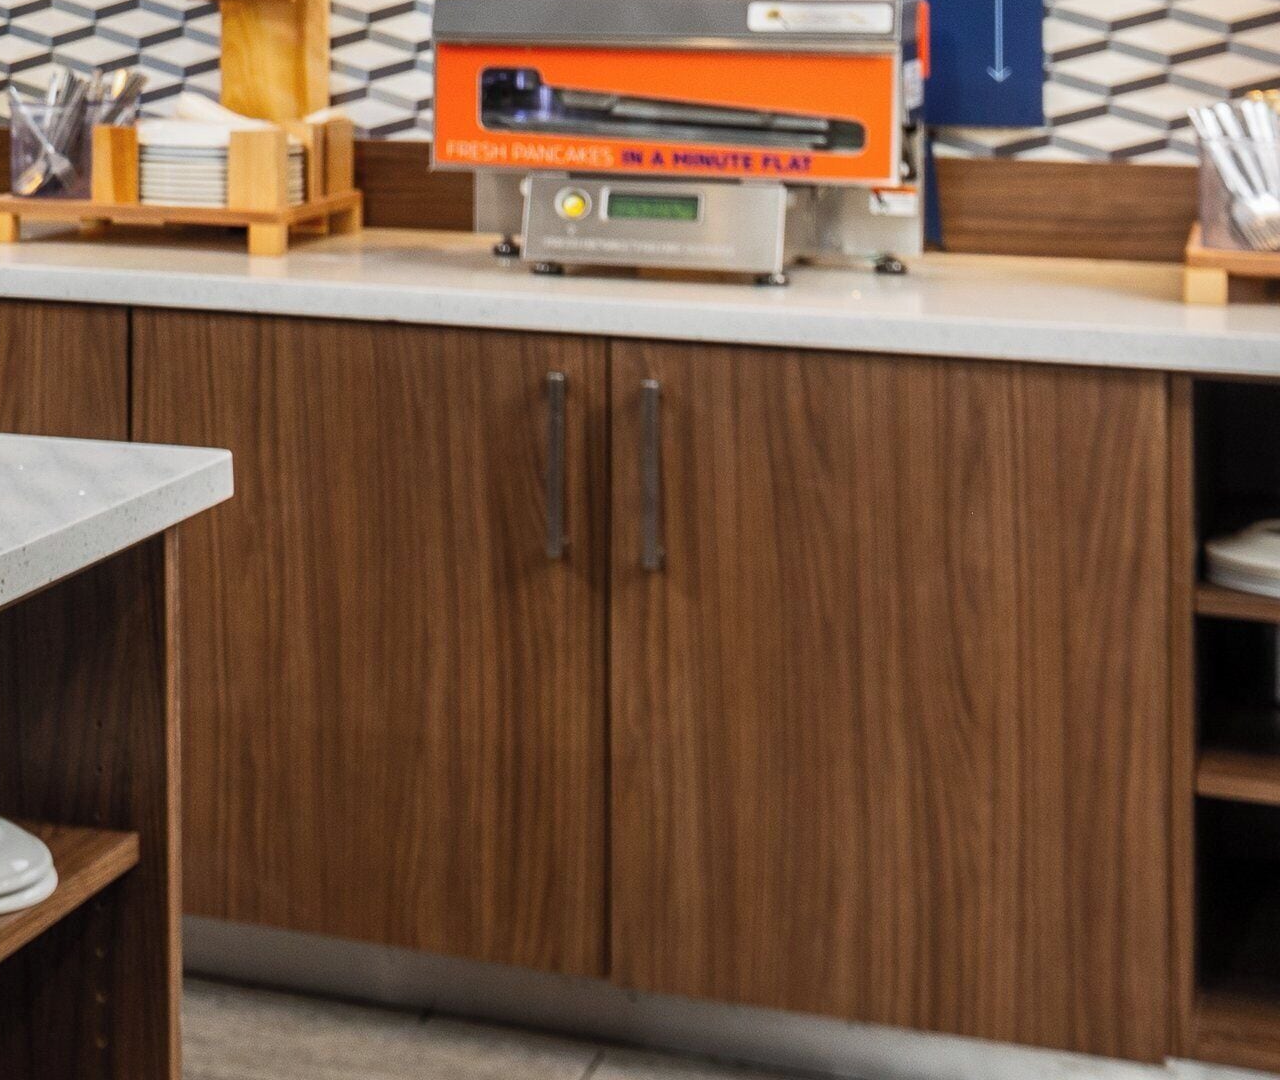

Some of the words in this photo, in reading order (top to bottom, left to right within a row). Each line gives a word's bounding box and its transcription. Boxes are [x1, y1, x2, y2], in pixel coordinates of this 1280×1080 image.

[445, 139, 507, 161] FRESH
[511, 142, 614, 166] PANCAKES
[621, 150, 643, 165] IN
[650, 150, 664, 166] A
[673, 151, 752, 170] MINUTE
[761, 154, 812, 171] FLAT
